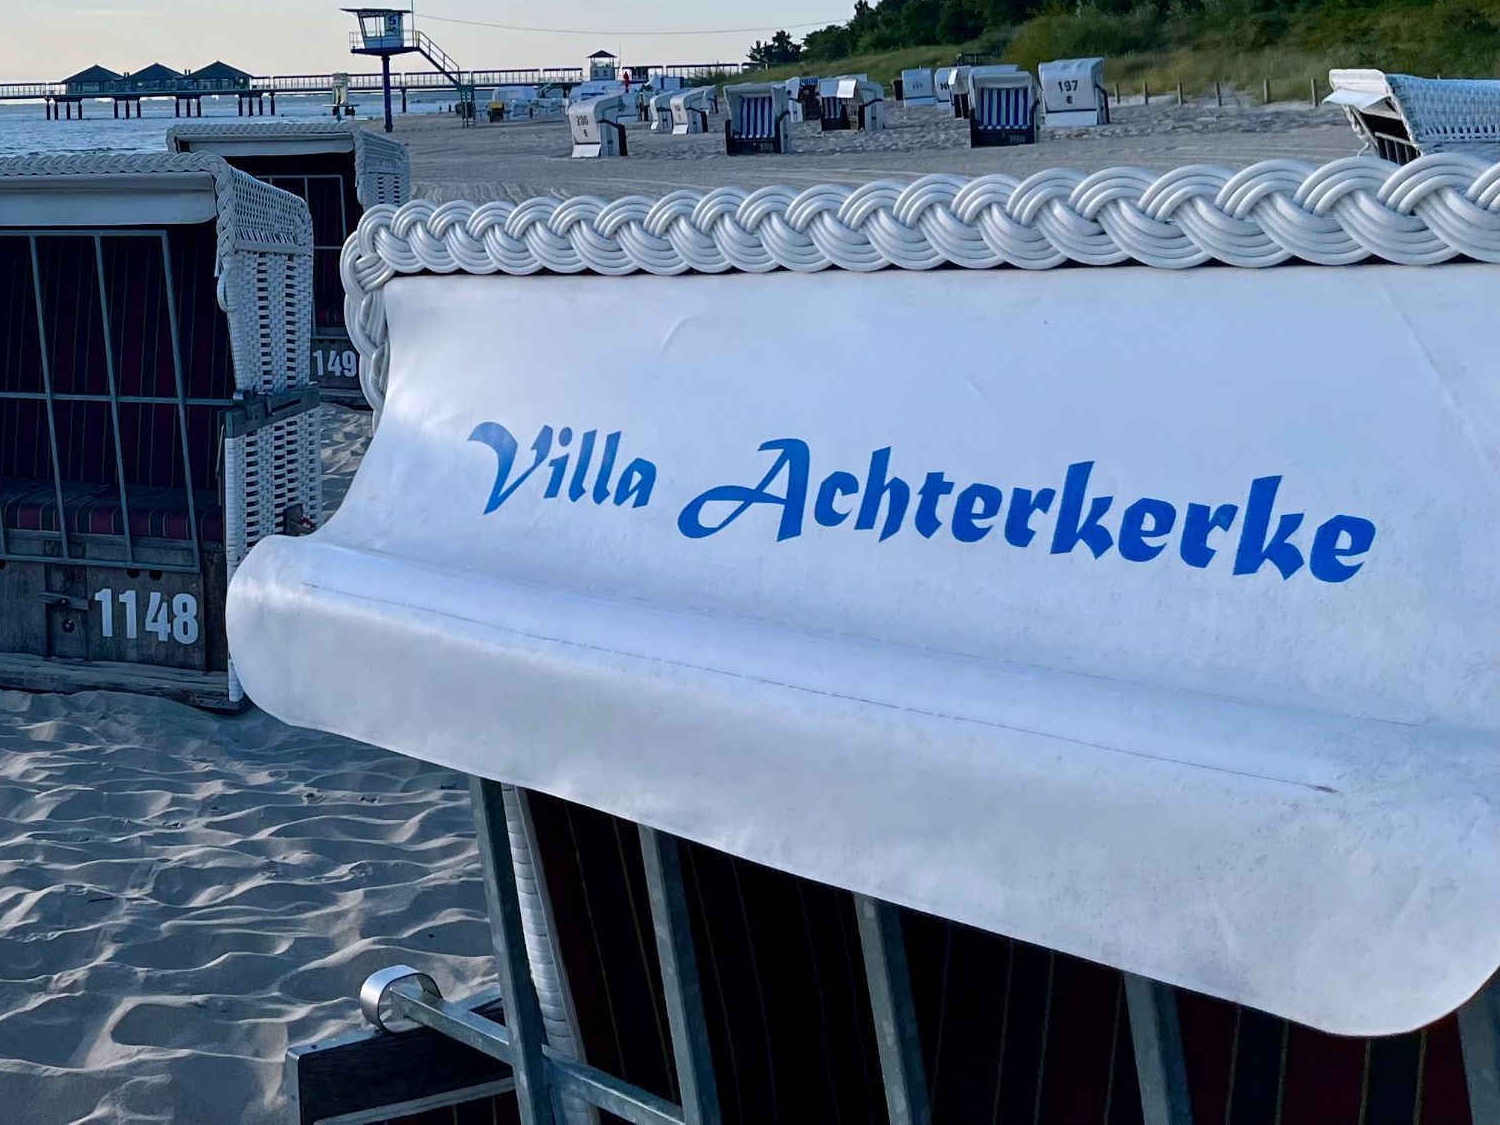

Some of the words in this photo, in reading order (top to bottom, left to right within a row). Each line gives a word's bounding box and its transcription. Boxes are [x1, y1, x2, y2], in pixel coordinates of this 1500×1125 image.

[1057, 79, 1078, 92] 197
[469, 421, 657, 516] Villa
[677, 437, 1377, 584] Achterkerke
[94, 588, 199, 644] 1148
